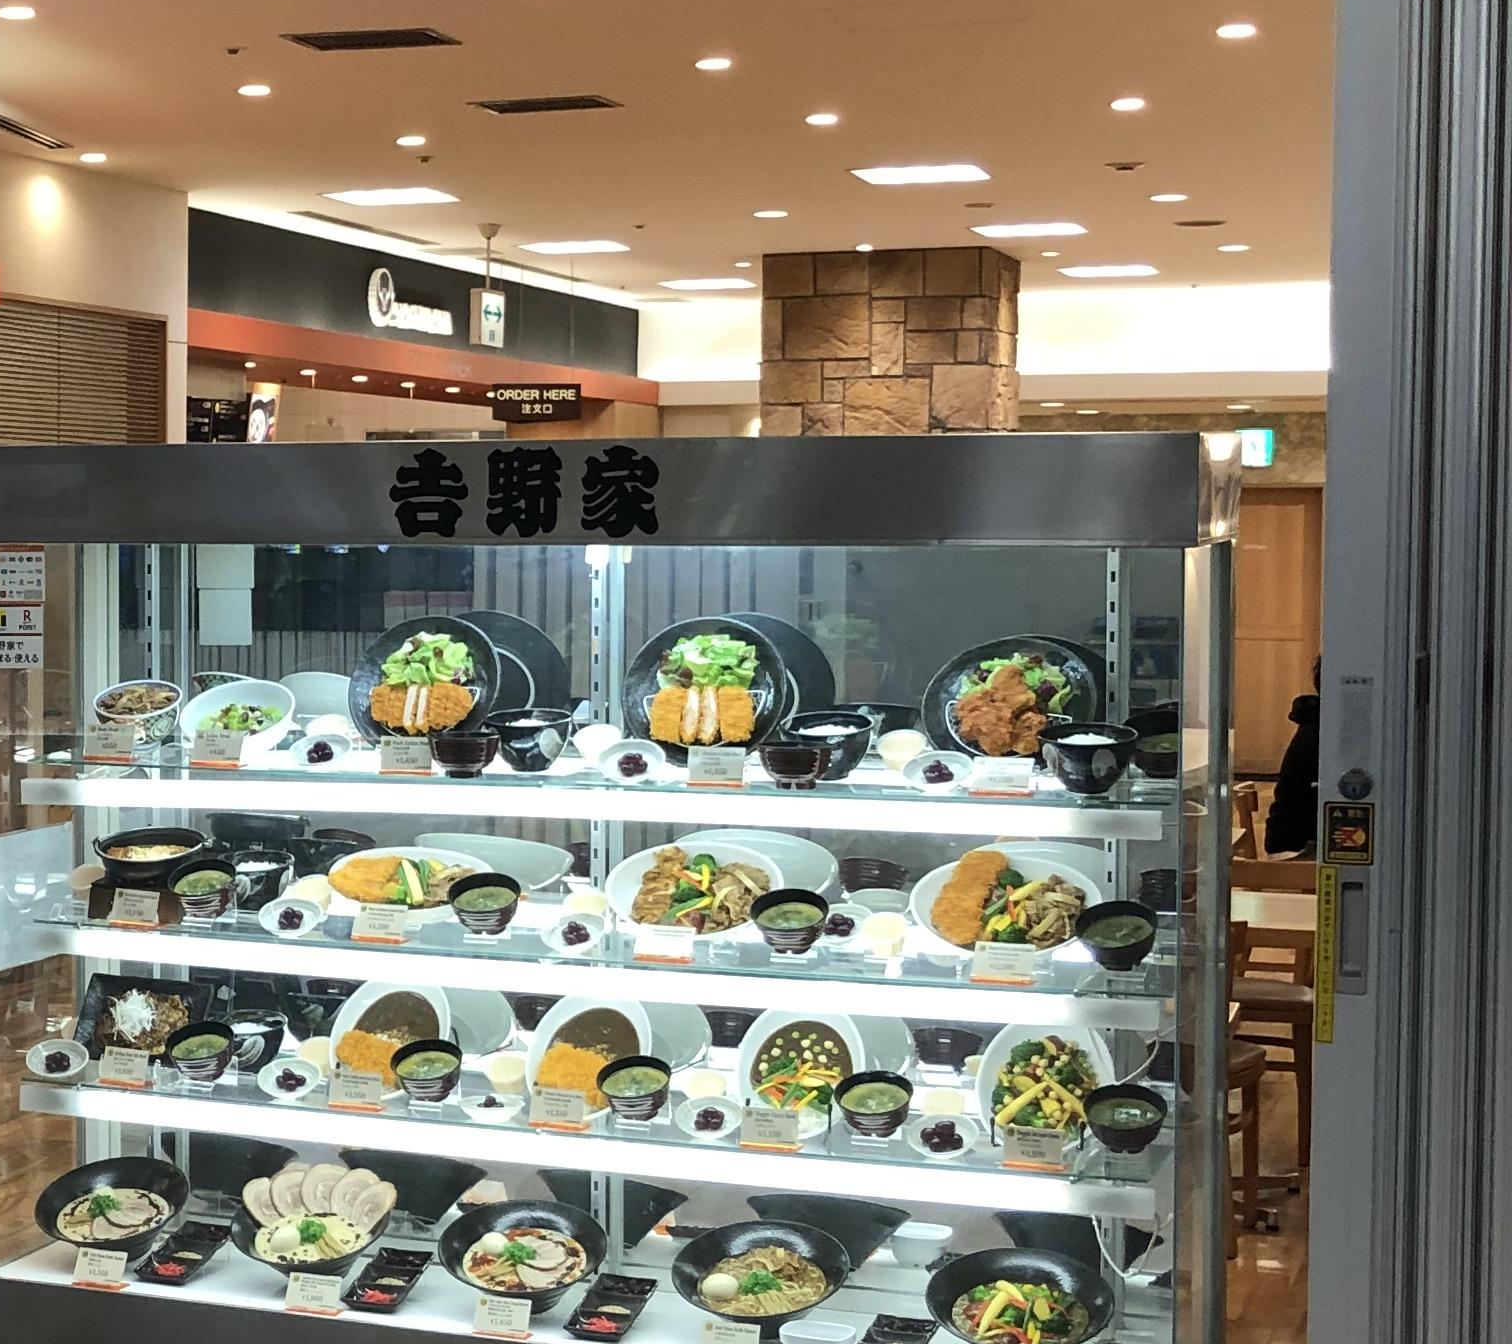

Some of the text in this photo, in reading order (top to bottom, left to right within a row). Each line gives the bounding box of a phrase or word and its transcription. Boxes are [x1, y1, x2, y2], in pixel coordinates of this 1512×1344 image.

[496, 389, 576, 401] ORDER HERE
[521, 403, 553, 414] 注文口
